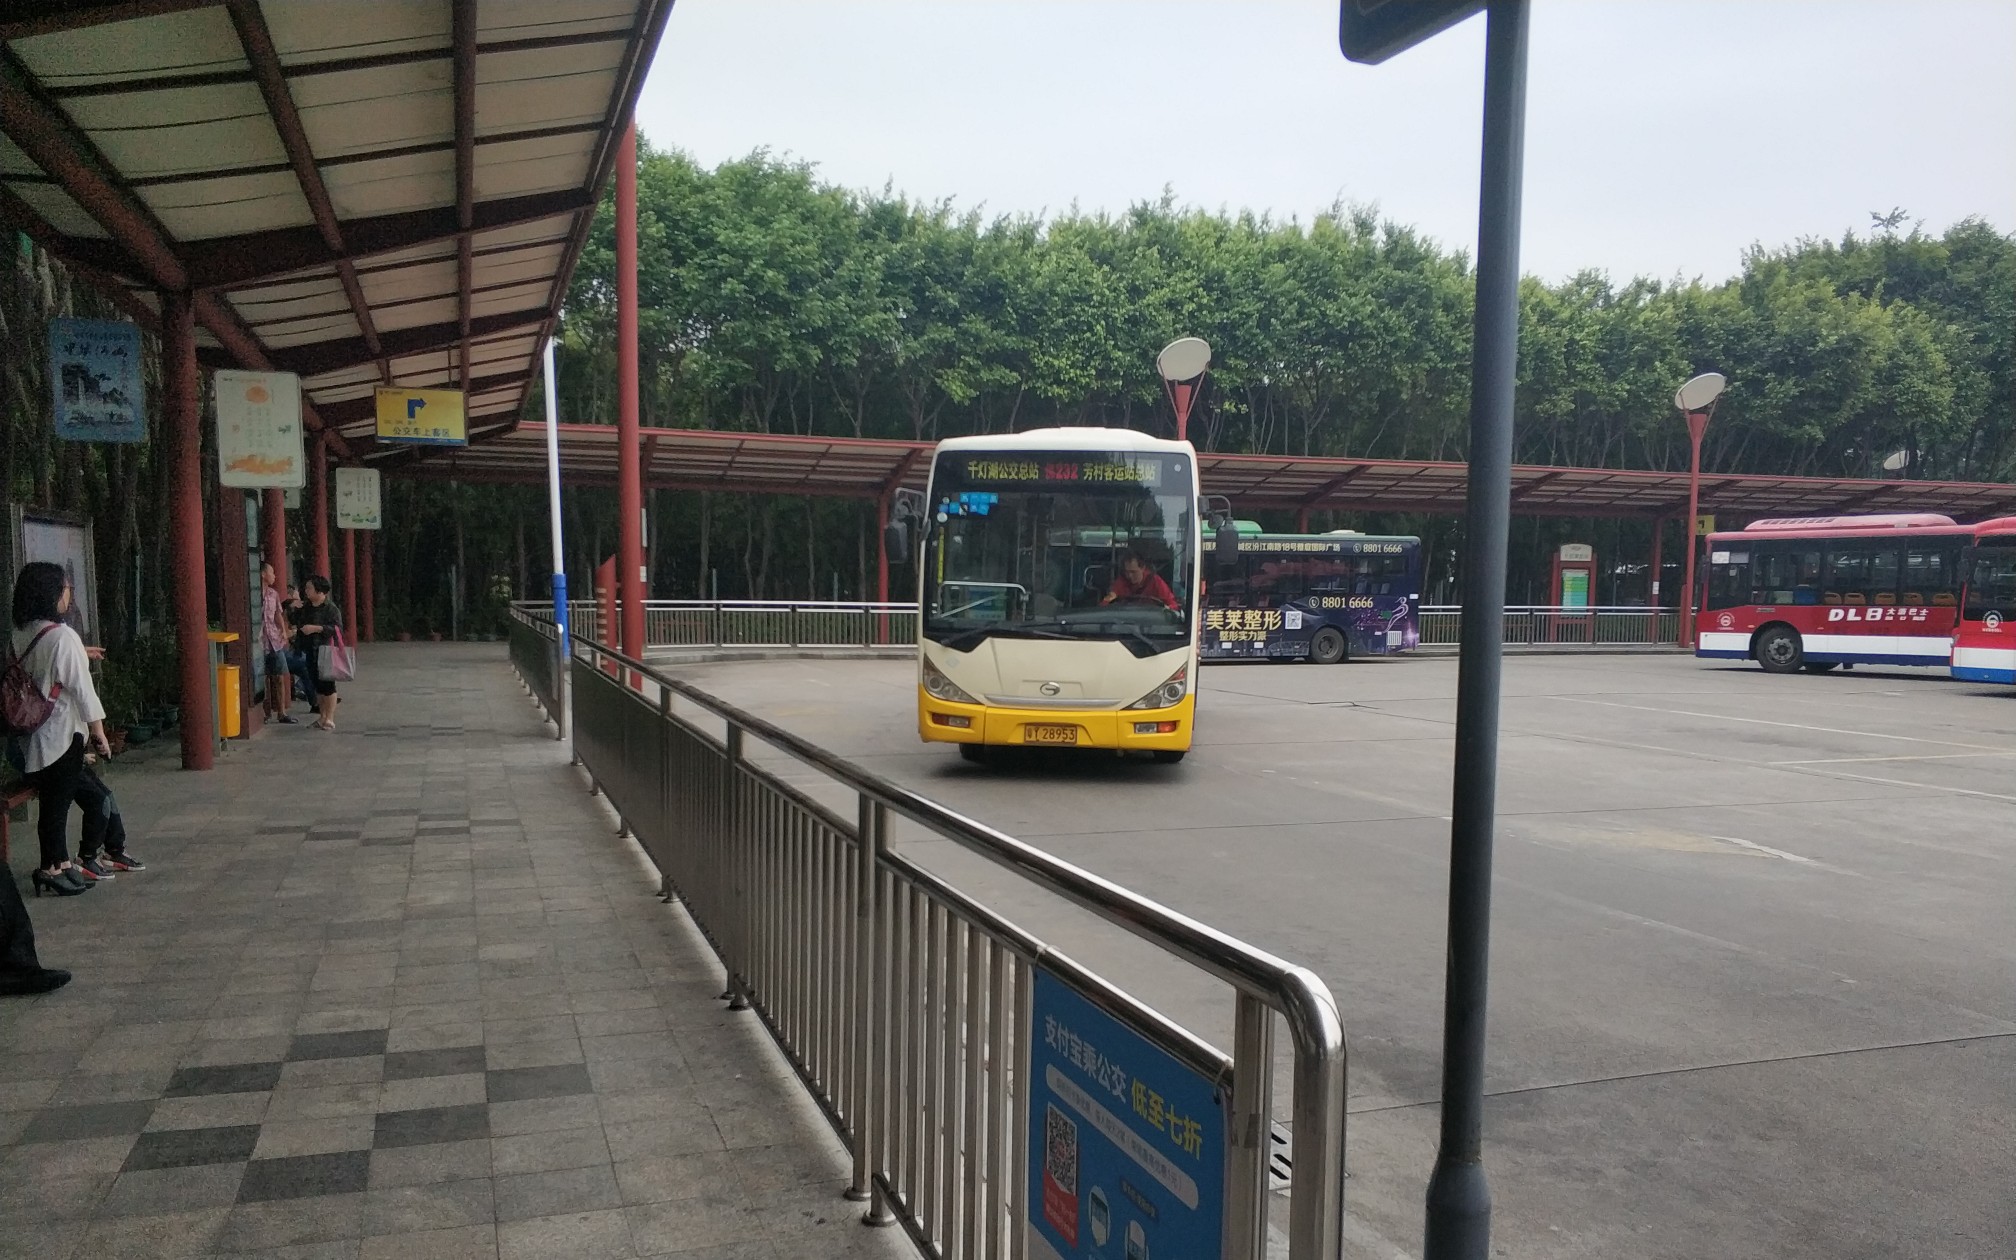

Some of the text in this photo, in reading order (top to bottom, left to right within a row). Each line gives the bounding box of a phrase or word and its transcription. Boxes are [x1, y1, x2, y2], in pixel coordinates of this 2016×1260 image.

[393, 426, 450, 437] 公交车上客区
[968, 461, 1039, 480] 千灯湖公交总站
[1083, 462, 1156, 481] 芳村客运站总站
[1363, 544, 1382, 553] 8801
[1383, 544, 1402, 554] 6666
[1322, 597, 1373, 609] 8801 6666
[1206, 610, 1282, 631] 美莱整形
[1828, 608, 1883, 621] DLB
[1045, 1014, 1126, 1103] 支付宝乘公交
[1132, 1077, 1203, 1160] 低至七折
